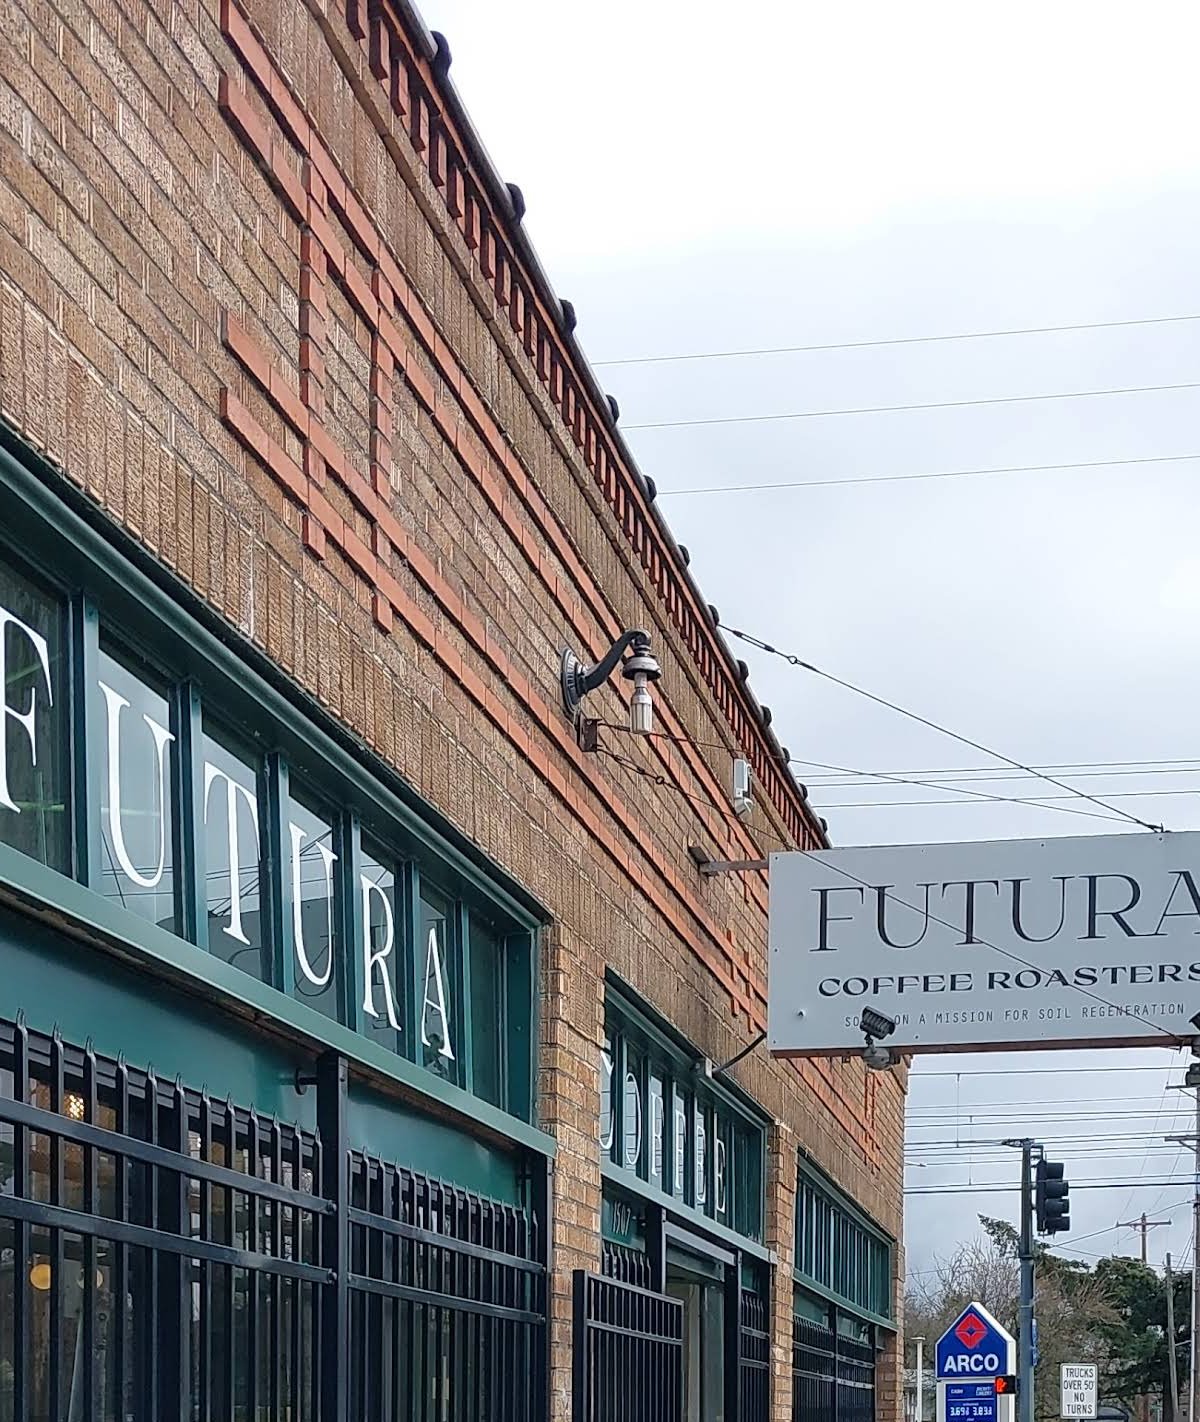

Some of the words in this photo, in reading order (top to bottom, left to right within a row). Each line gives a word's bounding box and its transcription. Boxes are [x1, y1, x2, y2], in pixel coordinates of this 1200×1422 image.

[0, 615, 456, 1060] FUTURA
[809, 870, 1200, 952] FUTURA
[818, 973, 973, 997] COFFEE
[895, 1014, 909, 1025] ON
[919, 1013, 926, 1025] A
[936, 1011, 993, 1024] MISSION
[1005, 1009, 1029, 1021] FOR
[1039, 1008, 1071, 1020] SOIL
[1082, 1003, 1184, 1018] REGENERATION
[944, 1353, 999, 1373] ARCO
[1066, 1368, 1093, 1378] TRUCKS
[1064, 1380, 1081, 1390] OVER
[1074, 1392, 1085, 1402] NO
[1067, 1404, 1093, 1414] TURNS
